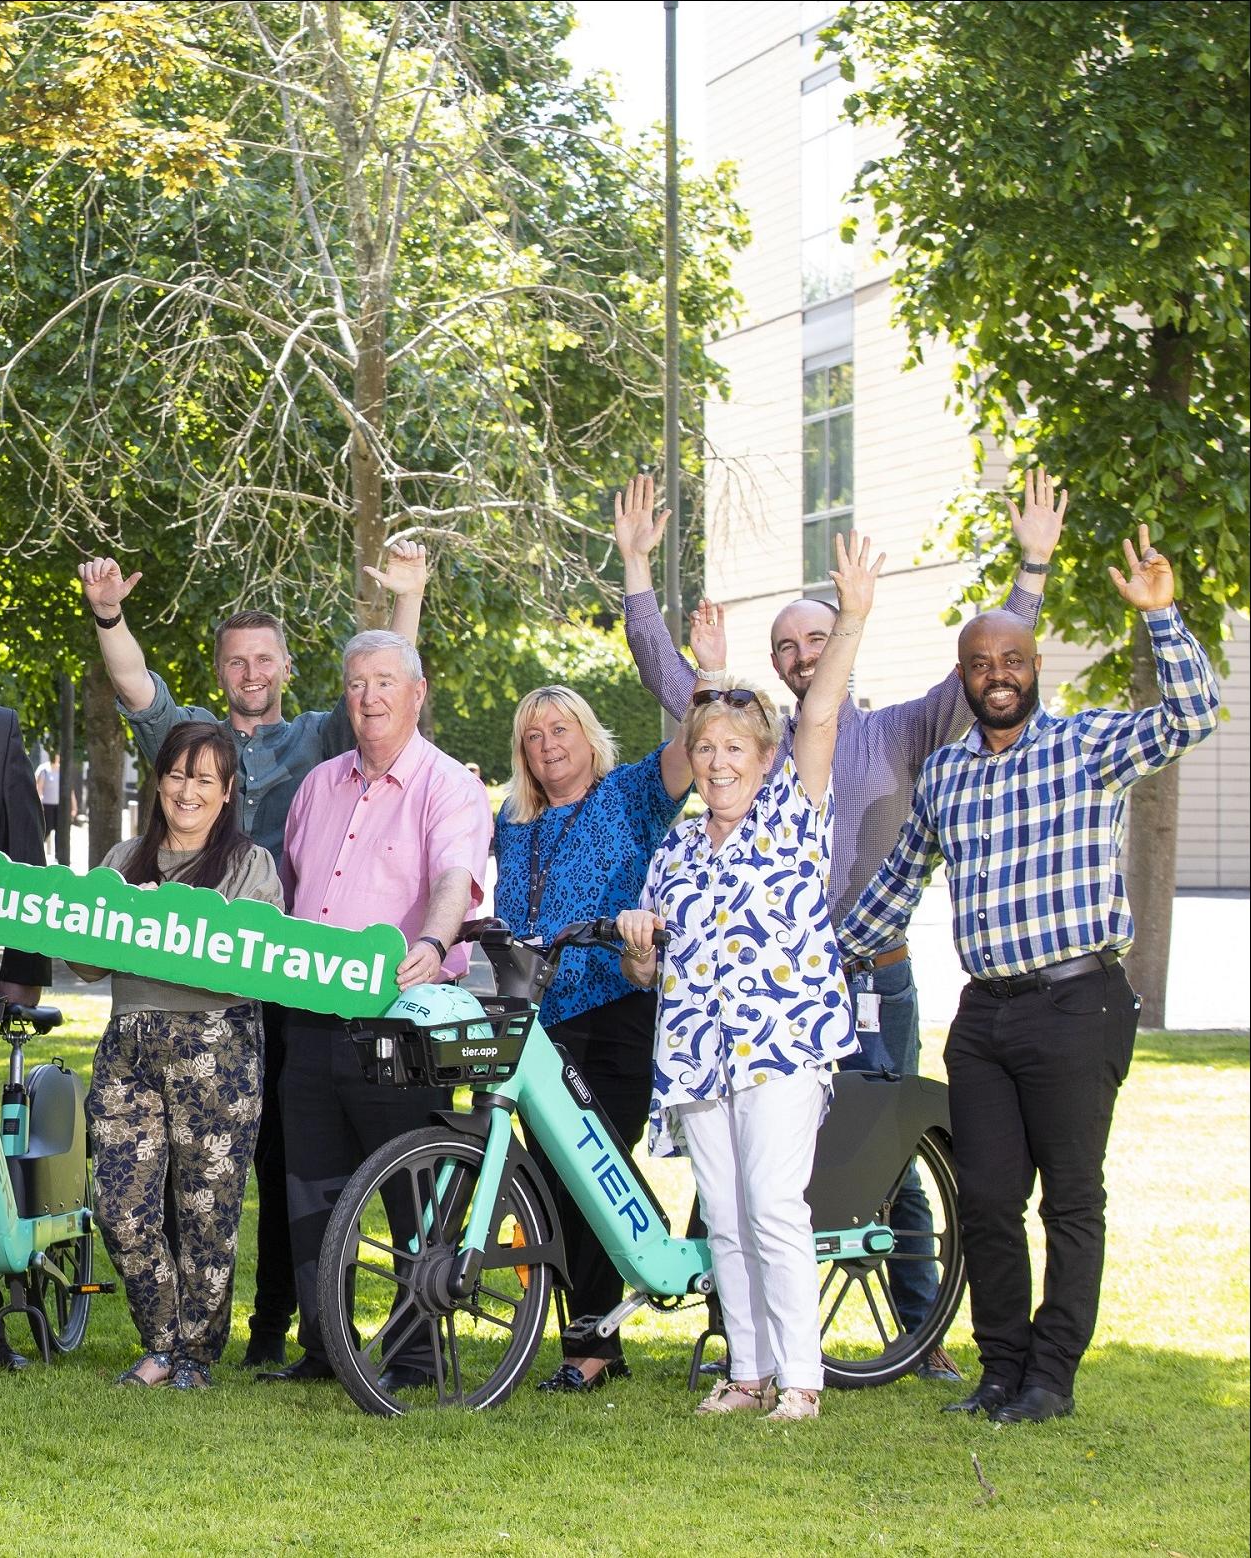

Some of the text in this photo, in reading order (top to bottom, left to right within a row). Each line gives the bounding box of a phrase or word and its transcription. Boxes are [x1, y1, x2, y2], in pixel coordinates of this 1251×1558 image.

[395, 1000, 431, 1018] TIER
[461, 1047, 498, 1058] tier.app
[577, 1116, 649, 1241] TIER
